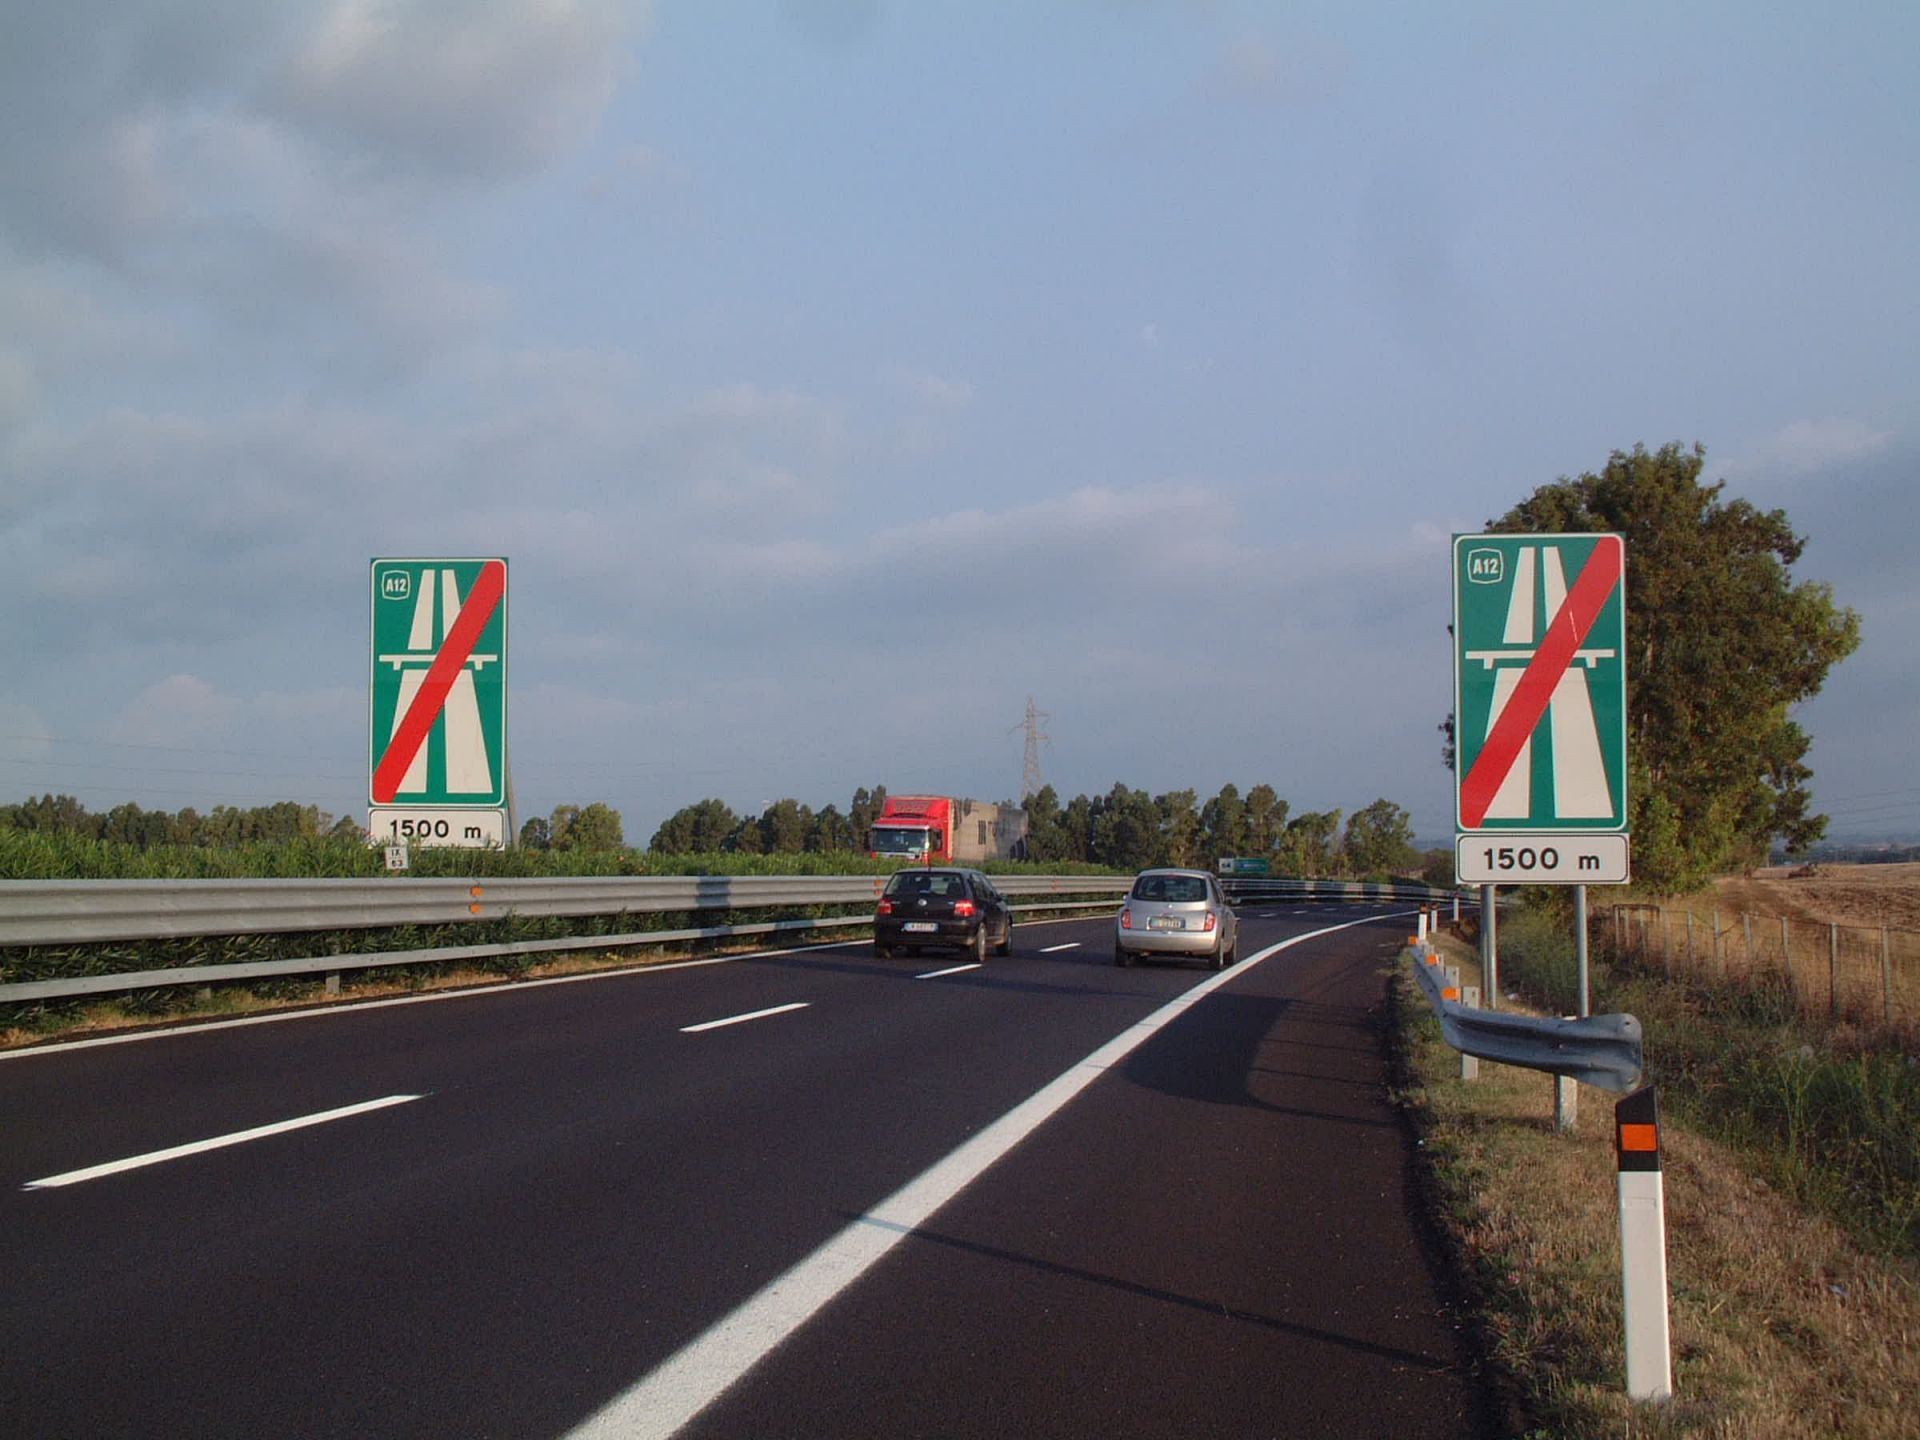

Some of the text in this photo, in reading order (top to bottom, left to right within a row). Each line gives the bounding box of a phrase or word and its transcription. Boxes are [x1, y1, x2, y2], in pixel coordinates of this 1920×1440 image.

[1473, 558, 1499, 574] A12
[386, 578, 407, 592] A12
[390, 819, 481, 839] 1500 m
[1484, 848, 1600, 870] 1500 m
